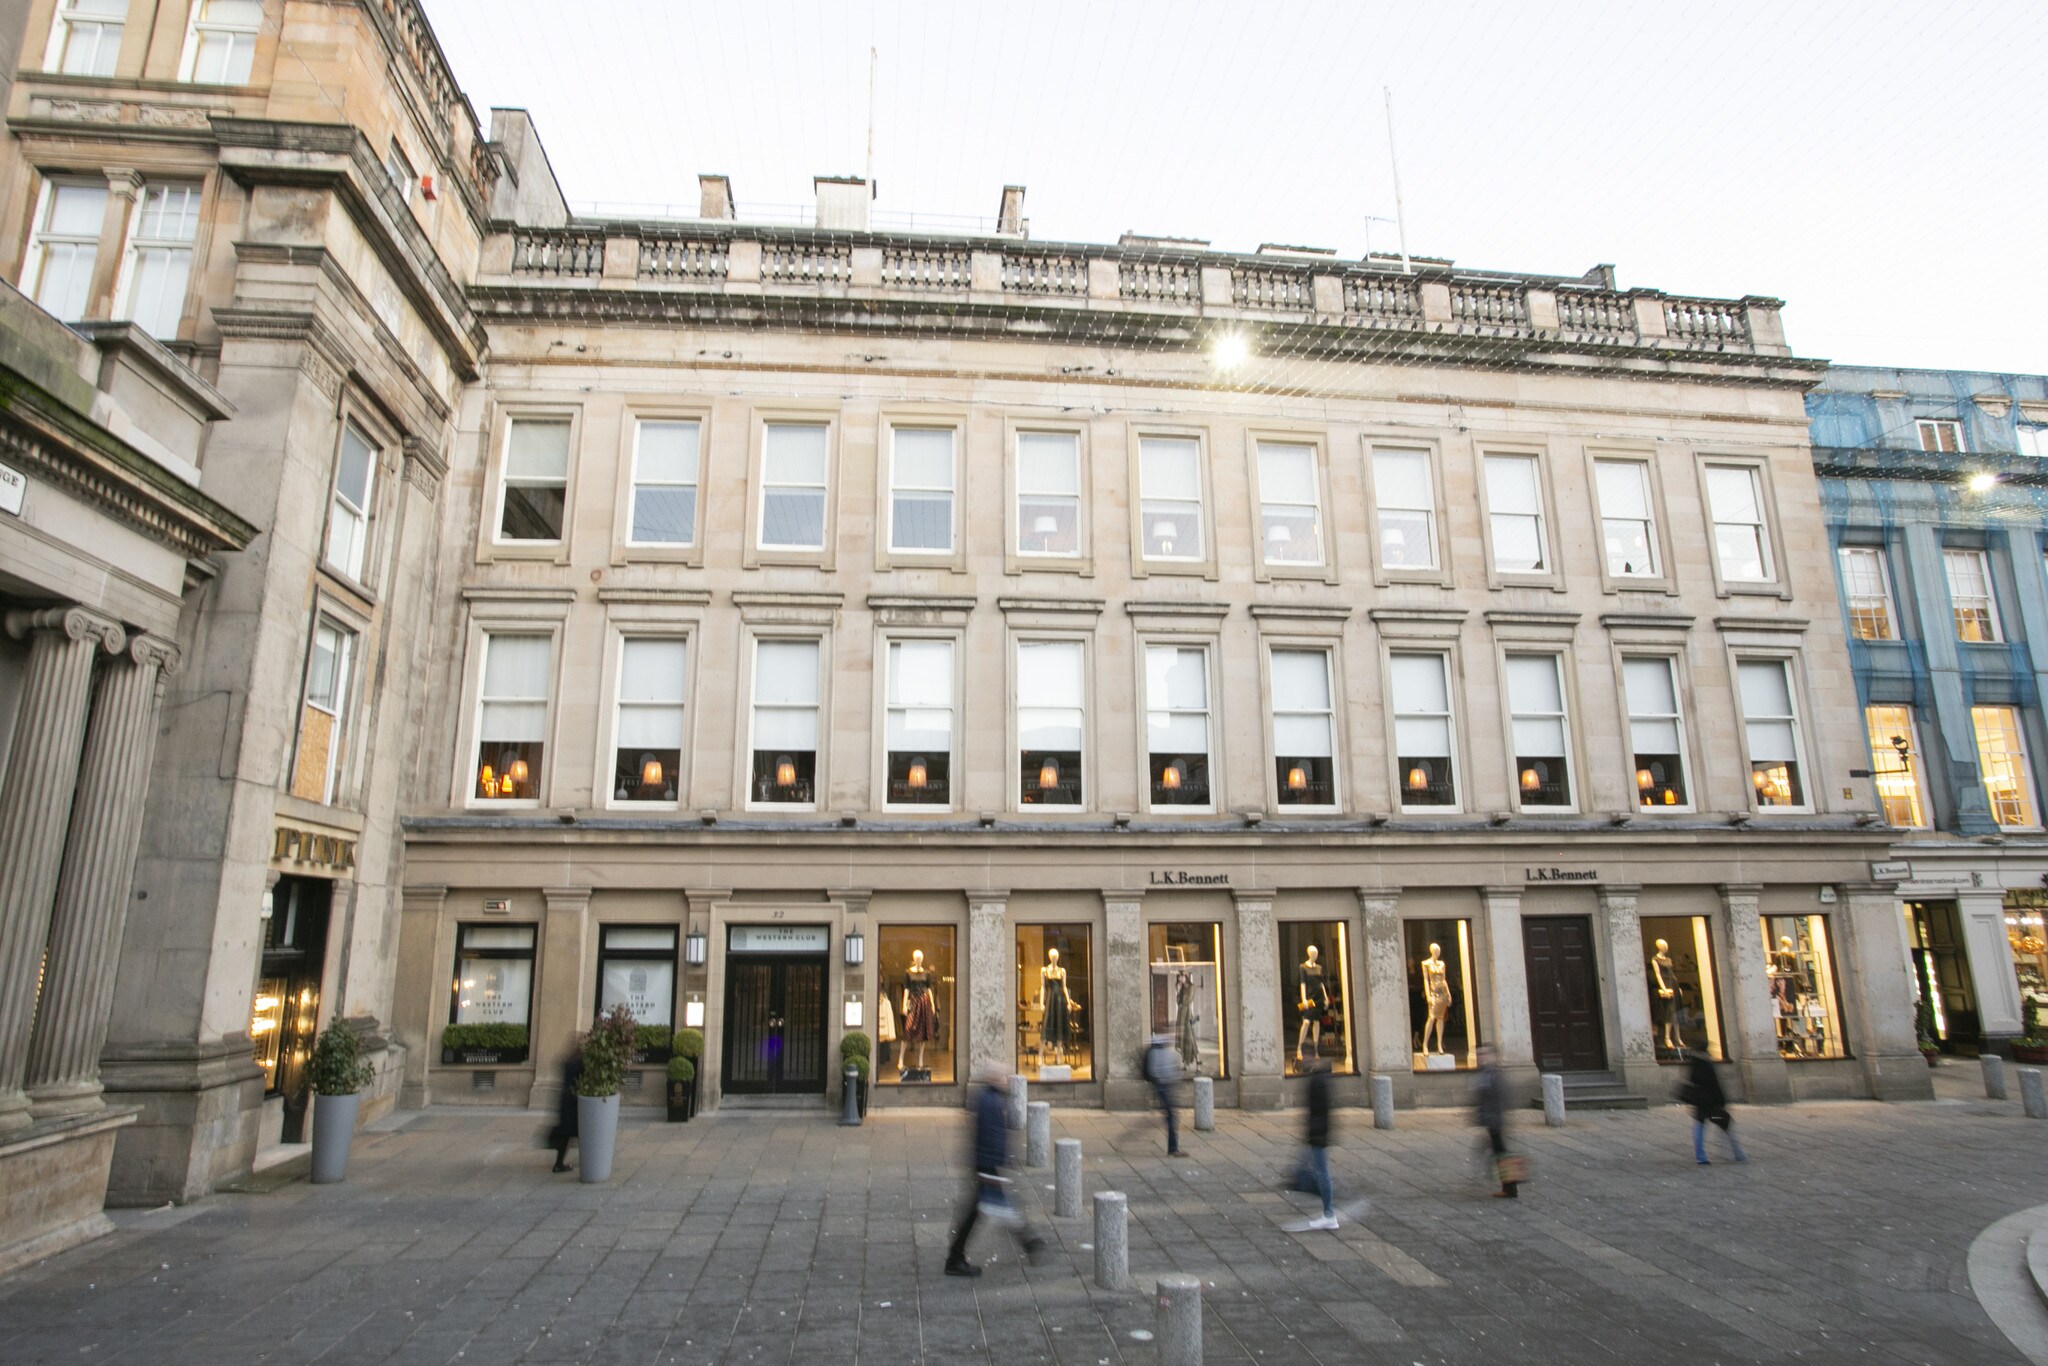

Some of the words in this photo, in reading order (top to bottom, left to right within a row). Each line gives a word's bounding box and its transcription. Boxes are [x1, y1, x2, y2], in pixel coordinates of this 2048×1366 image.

[272, 827, 357, 870] PINK
[1150, 871, 1229, 884] L.K.Bennett
[1526, 868, 1598, 881] L.K.Bennett
